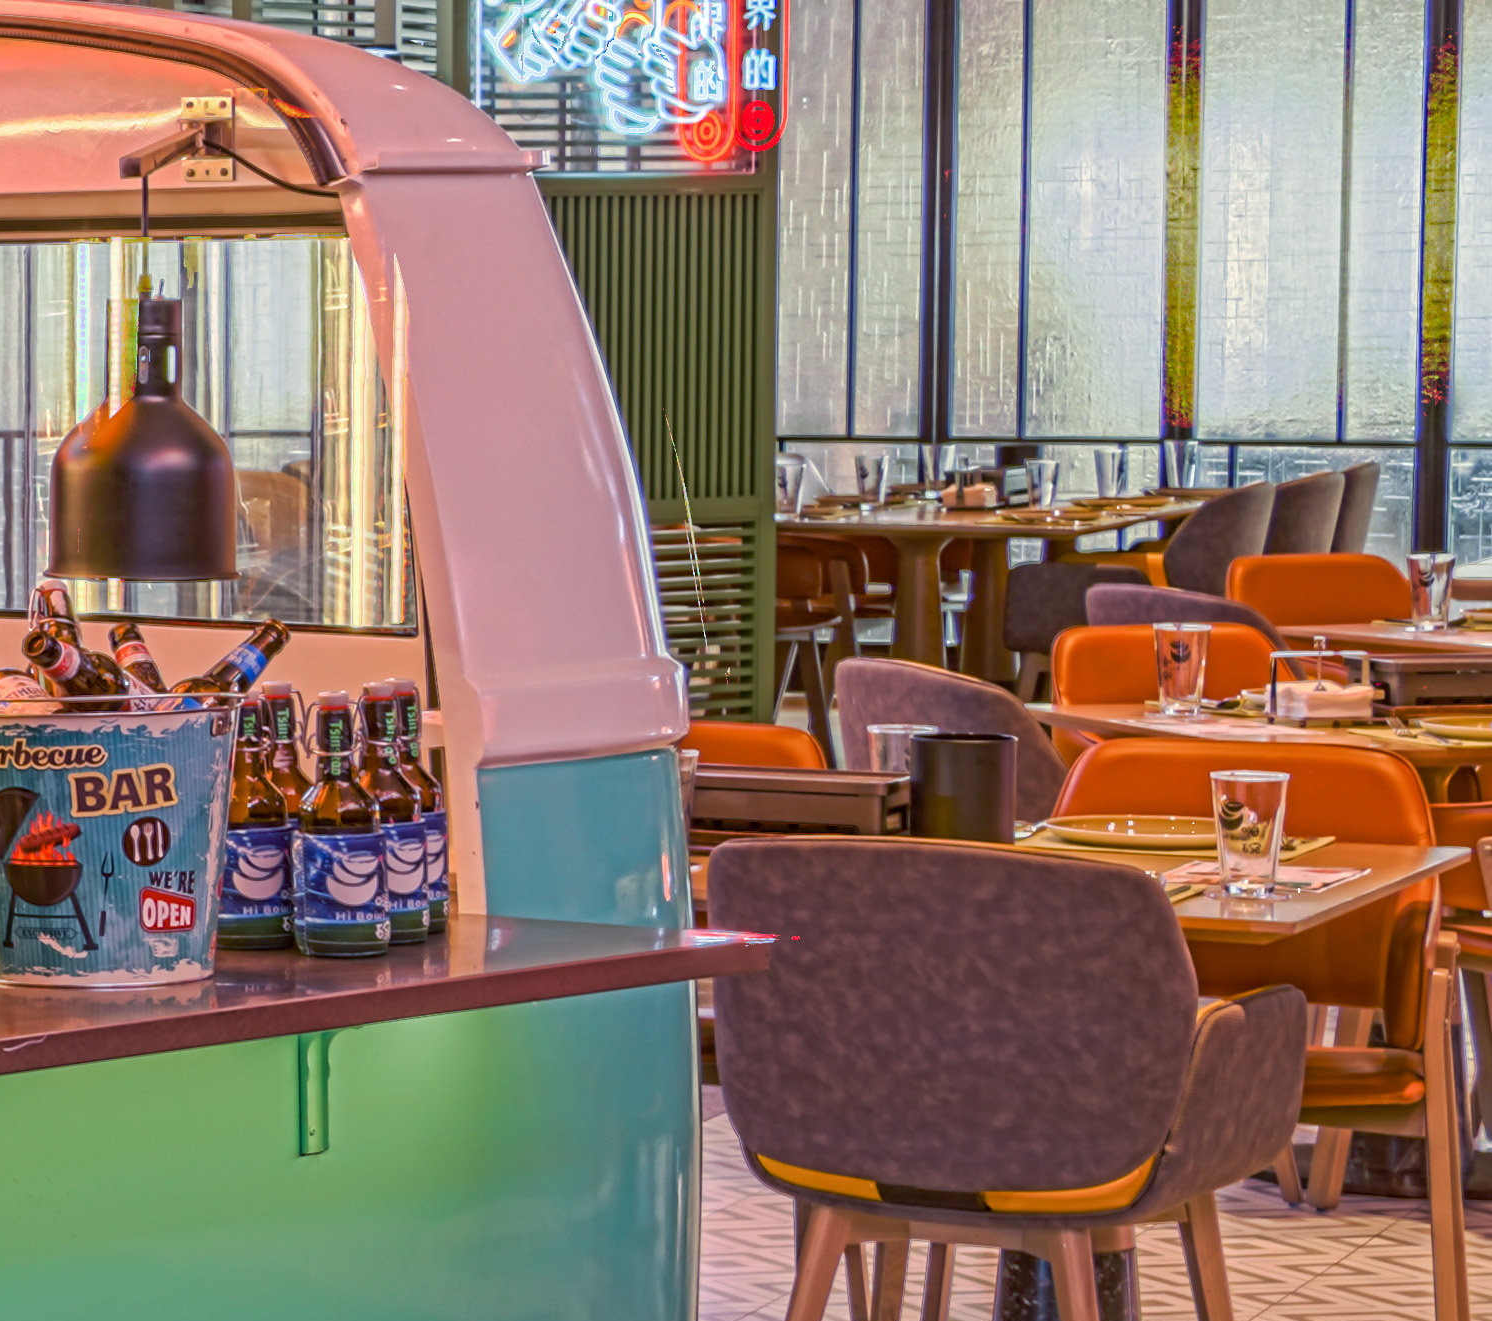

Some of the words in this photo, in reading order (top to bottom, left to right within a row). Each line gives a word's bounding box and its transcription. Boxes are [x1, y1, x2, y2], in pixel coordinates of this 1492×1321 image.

[72, 766, 175, 814] BAR
[148, 870, 196, 894] WE'RE
[142, 897, 192, 929] OPEN
[242, 905, 260, 915] Hi
[263, 904, 294, 915] Bowl
[390, 899, 405, 910] Hi
[335, 910, 354, 922] Hi
[356, 910, 386, 921] Bowl
